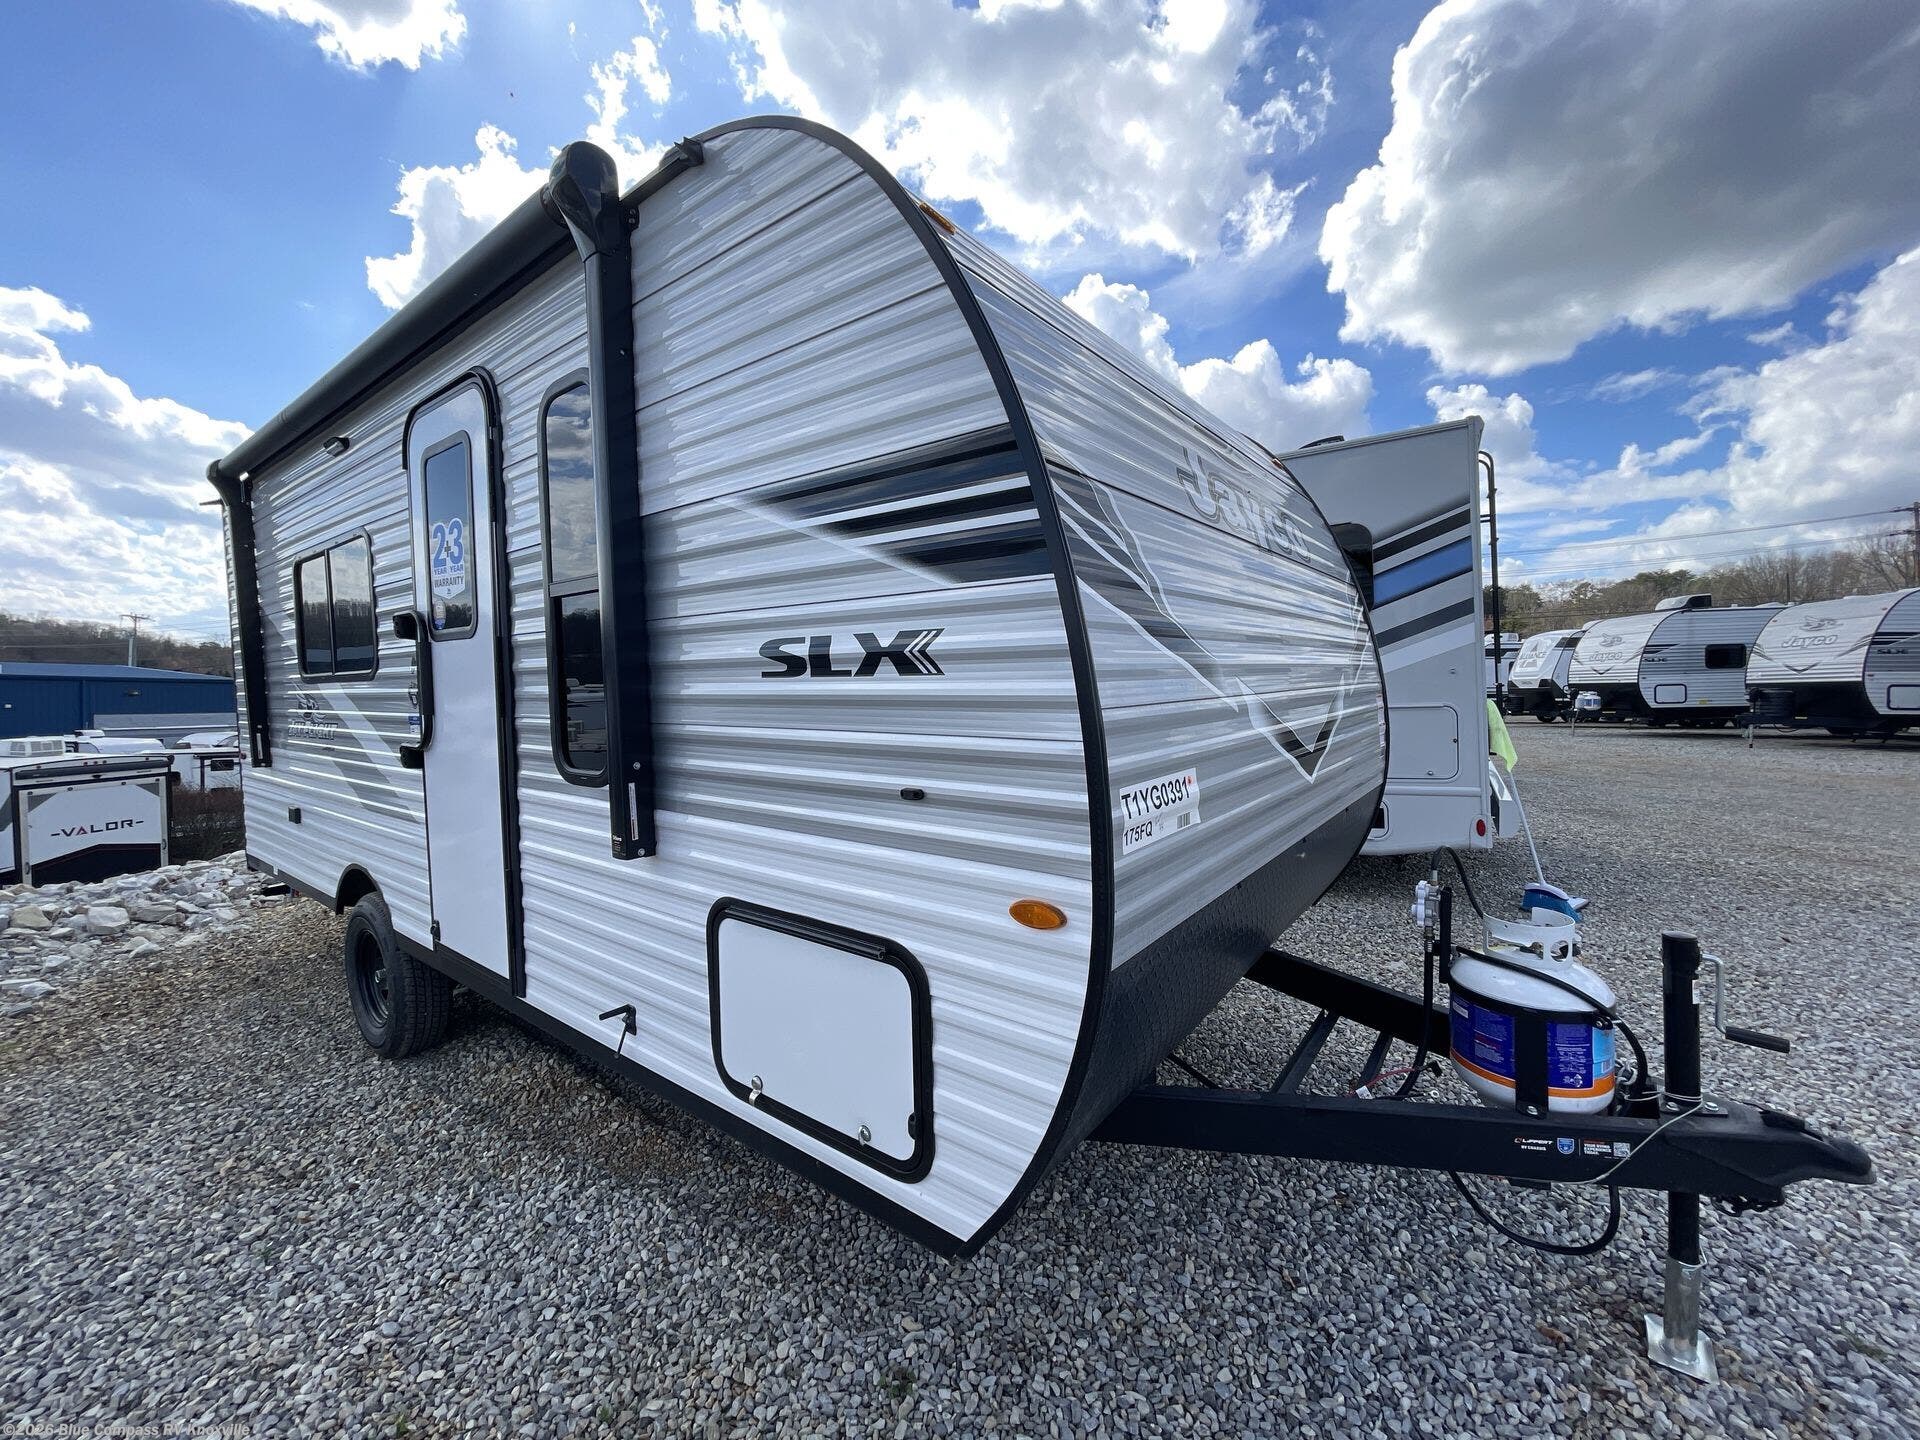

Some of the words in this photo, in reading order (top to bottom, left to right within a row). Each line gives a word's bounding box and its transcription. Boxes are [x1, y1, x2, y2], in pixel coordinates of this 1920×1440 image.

[1177, 446, 1311, 562] Jayco
[434, 567, 448, 575] YEAR
[450, 564, 464, 572] YEAR
[434, 576, 464, 588] WARRANTY
[759, 628, 945, 678] SLX
[1782, 635, 1838, 648] Jayco
[1121, 776, 1190, 819] T1YG0391
[1124, 821, 1153, 846] 175FQ
